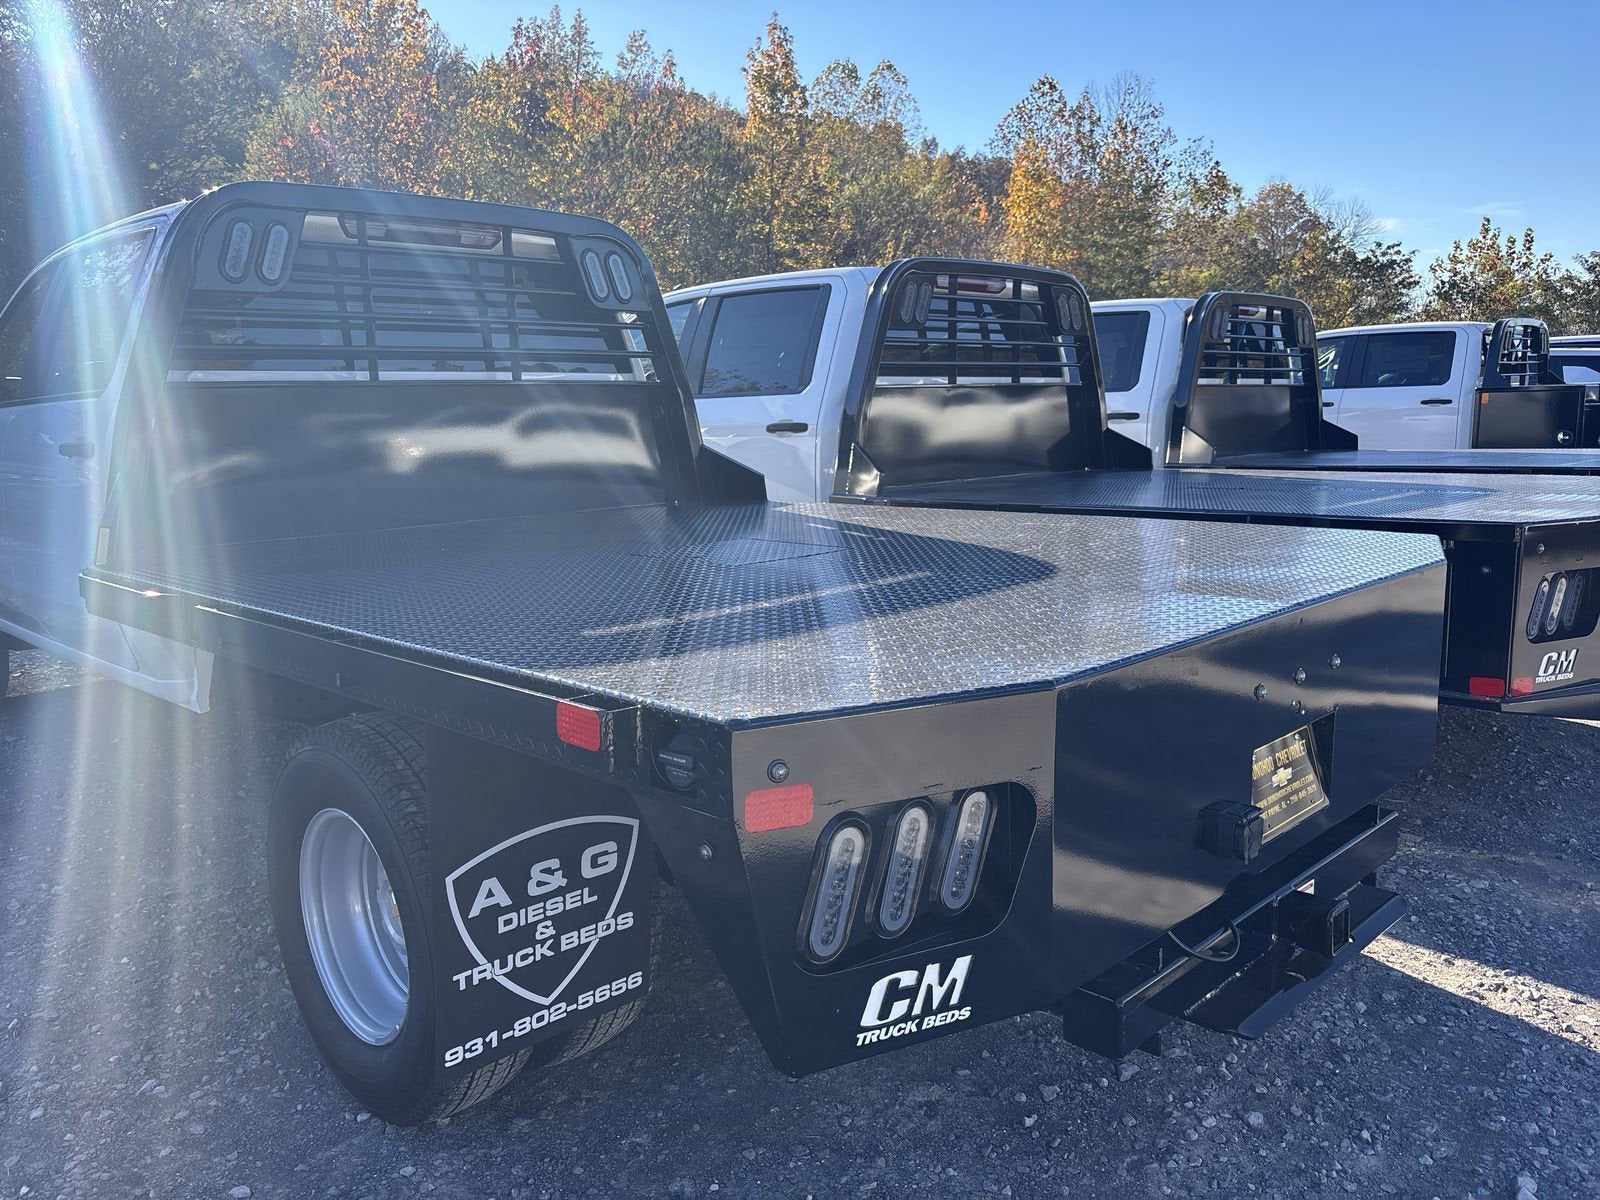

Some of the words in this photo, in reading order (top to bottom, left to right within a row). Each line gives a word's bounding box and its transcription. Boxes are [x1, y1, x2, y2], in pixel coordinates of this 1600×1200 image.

[1535, 673, 1557, 684] TRUCK
[1557, 672, 1574, 681] BEDS
[1538, 649, 1579, 677] CM
[1252, 756, 1274, 780] ONOHOO
[1275, 740, 1306, 767] CHEVROLET
[468, 877, 513, 918] A
[527, 858, 568, 896] &
[581, 841, 618, 879] G
[497, 887, 598, 934] DIESEL
[535, 920, 556, 940] &
[452, 939, 555, 991] TRUCK
[560, 912, 634, 952] BEDS
[860, 954, 975, 1027] CM
[444, 971, 643, 1068] 931-802-5656
[856, 1018, 921, 1047] TRUCK
[921, 1005, 972, 1031] BEDS
